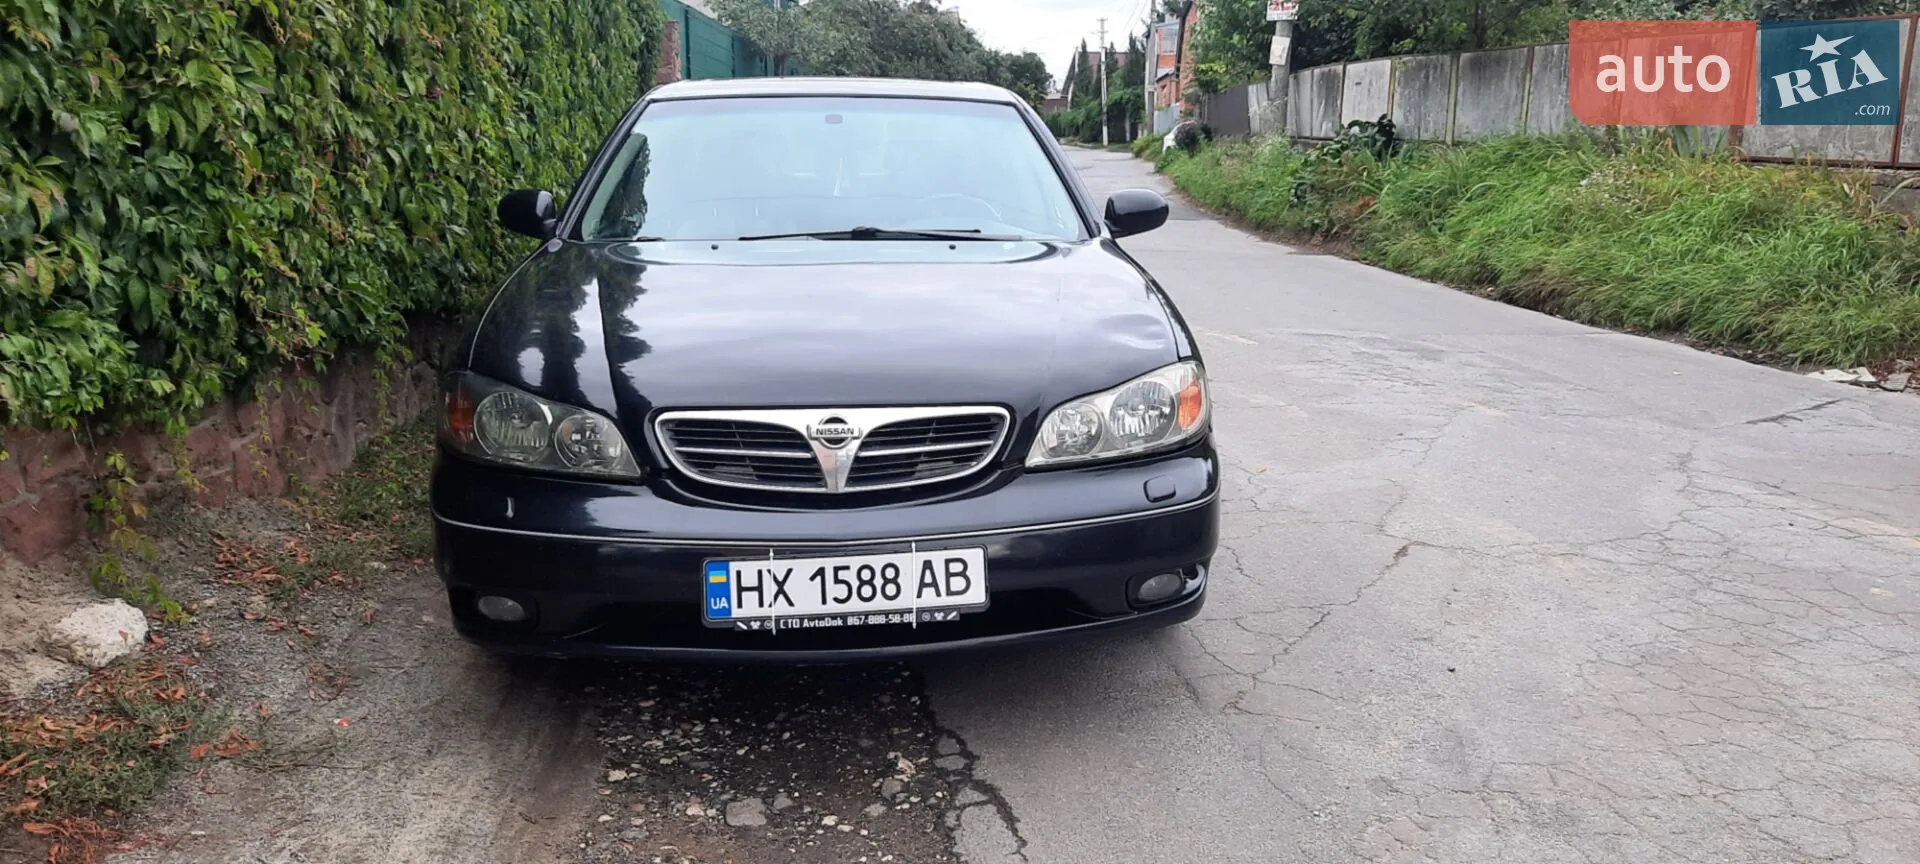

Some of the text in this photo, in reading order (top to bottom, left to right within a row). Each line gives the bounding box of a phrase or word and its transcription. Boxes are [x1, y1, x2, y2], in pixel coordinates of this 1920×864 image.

[815, 427, 855, 436] NISSAN
[735, 557, 972, 609] HX 1588 AB
[711, 597, 730, 610] UA
[803, 616, 844, 628] AvtoDok
